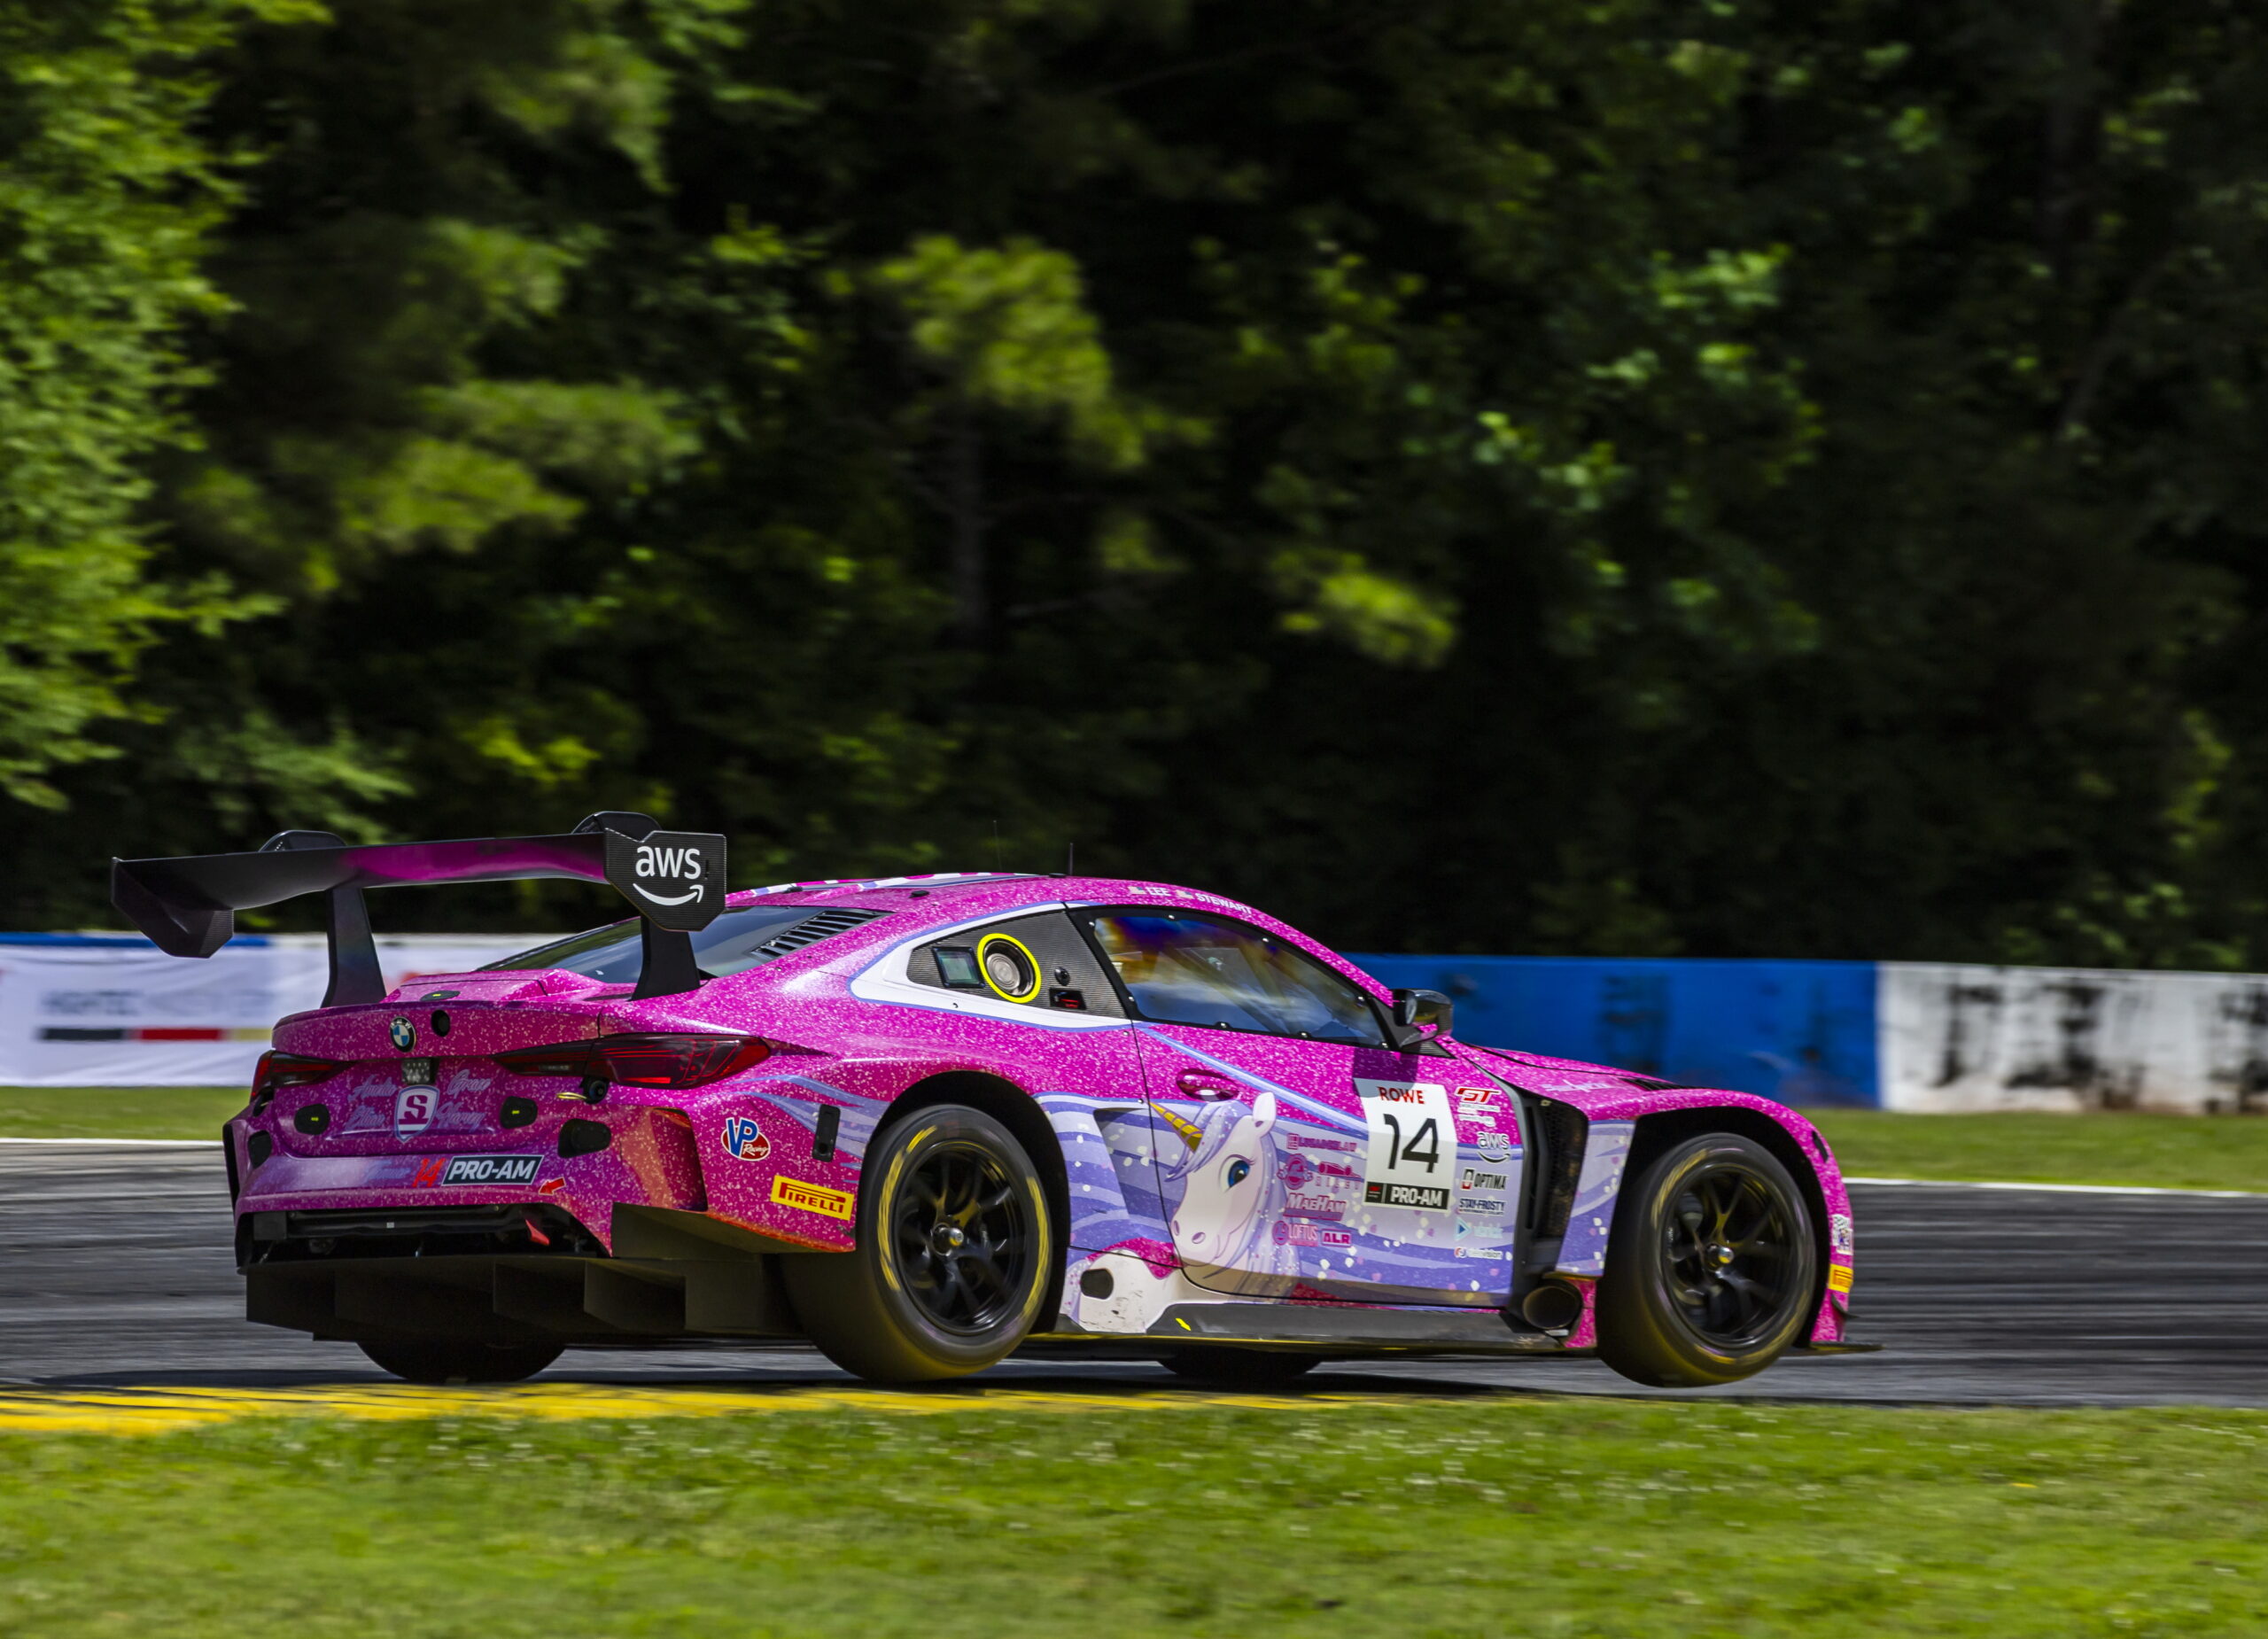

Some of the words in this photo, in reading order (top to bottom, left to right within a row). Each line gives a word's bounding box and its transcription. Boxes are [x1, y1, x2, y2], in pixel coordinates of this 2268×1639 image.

[635, 845, 701, 880] aws
[1146, 887, 1171, 897] LEE
[1195, 892, 1253, 914] STEWART
[1378, 1086, 1425, 1105] ROWE
[726, 1117, 758, 1157] VP
[1383, 1113, 1440, 1174] 14
[1477, 1131, 1510, 1150] aws
[412, 1158, 446, 1188] 14
[447, 1159, 536, 1182] PRO-AM
[1474, 1172, 1507, 1190] OPTIMA
[779, 1182, 846, 1213] PIRELLI
[1390, 1185, 1443, 1207] PRO-AM
